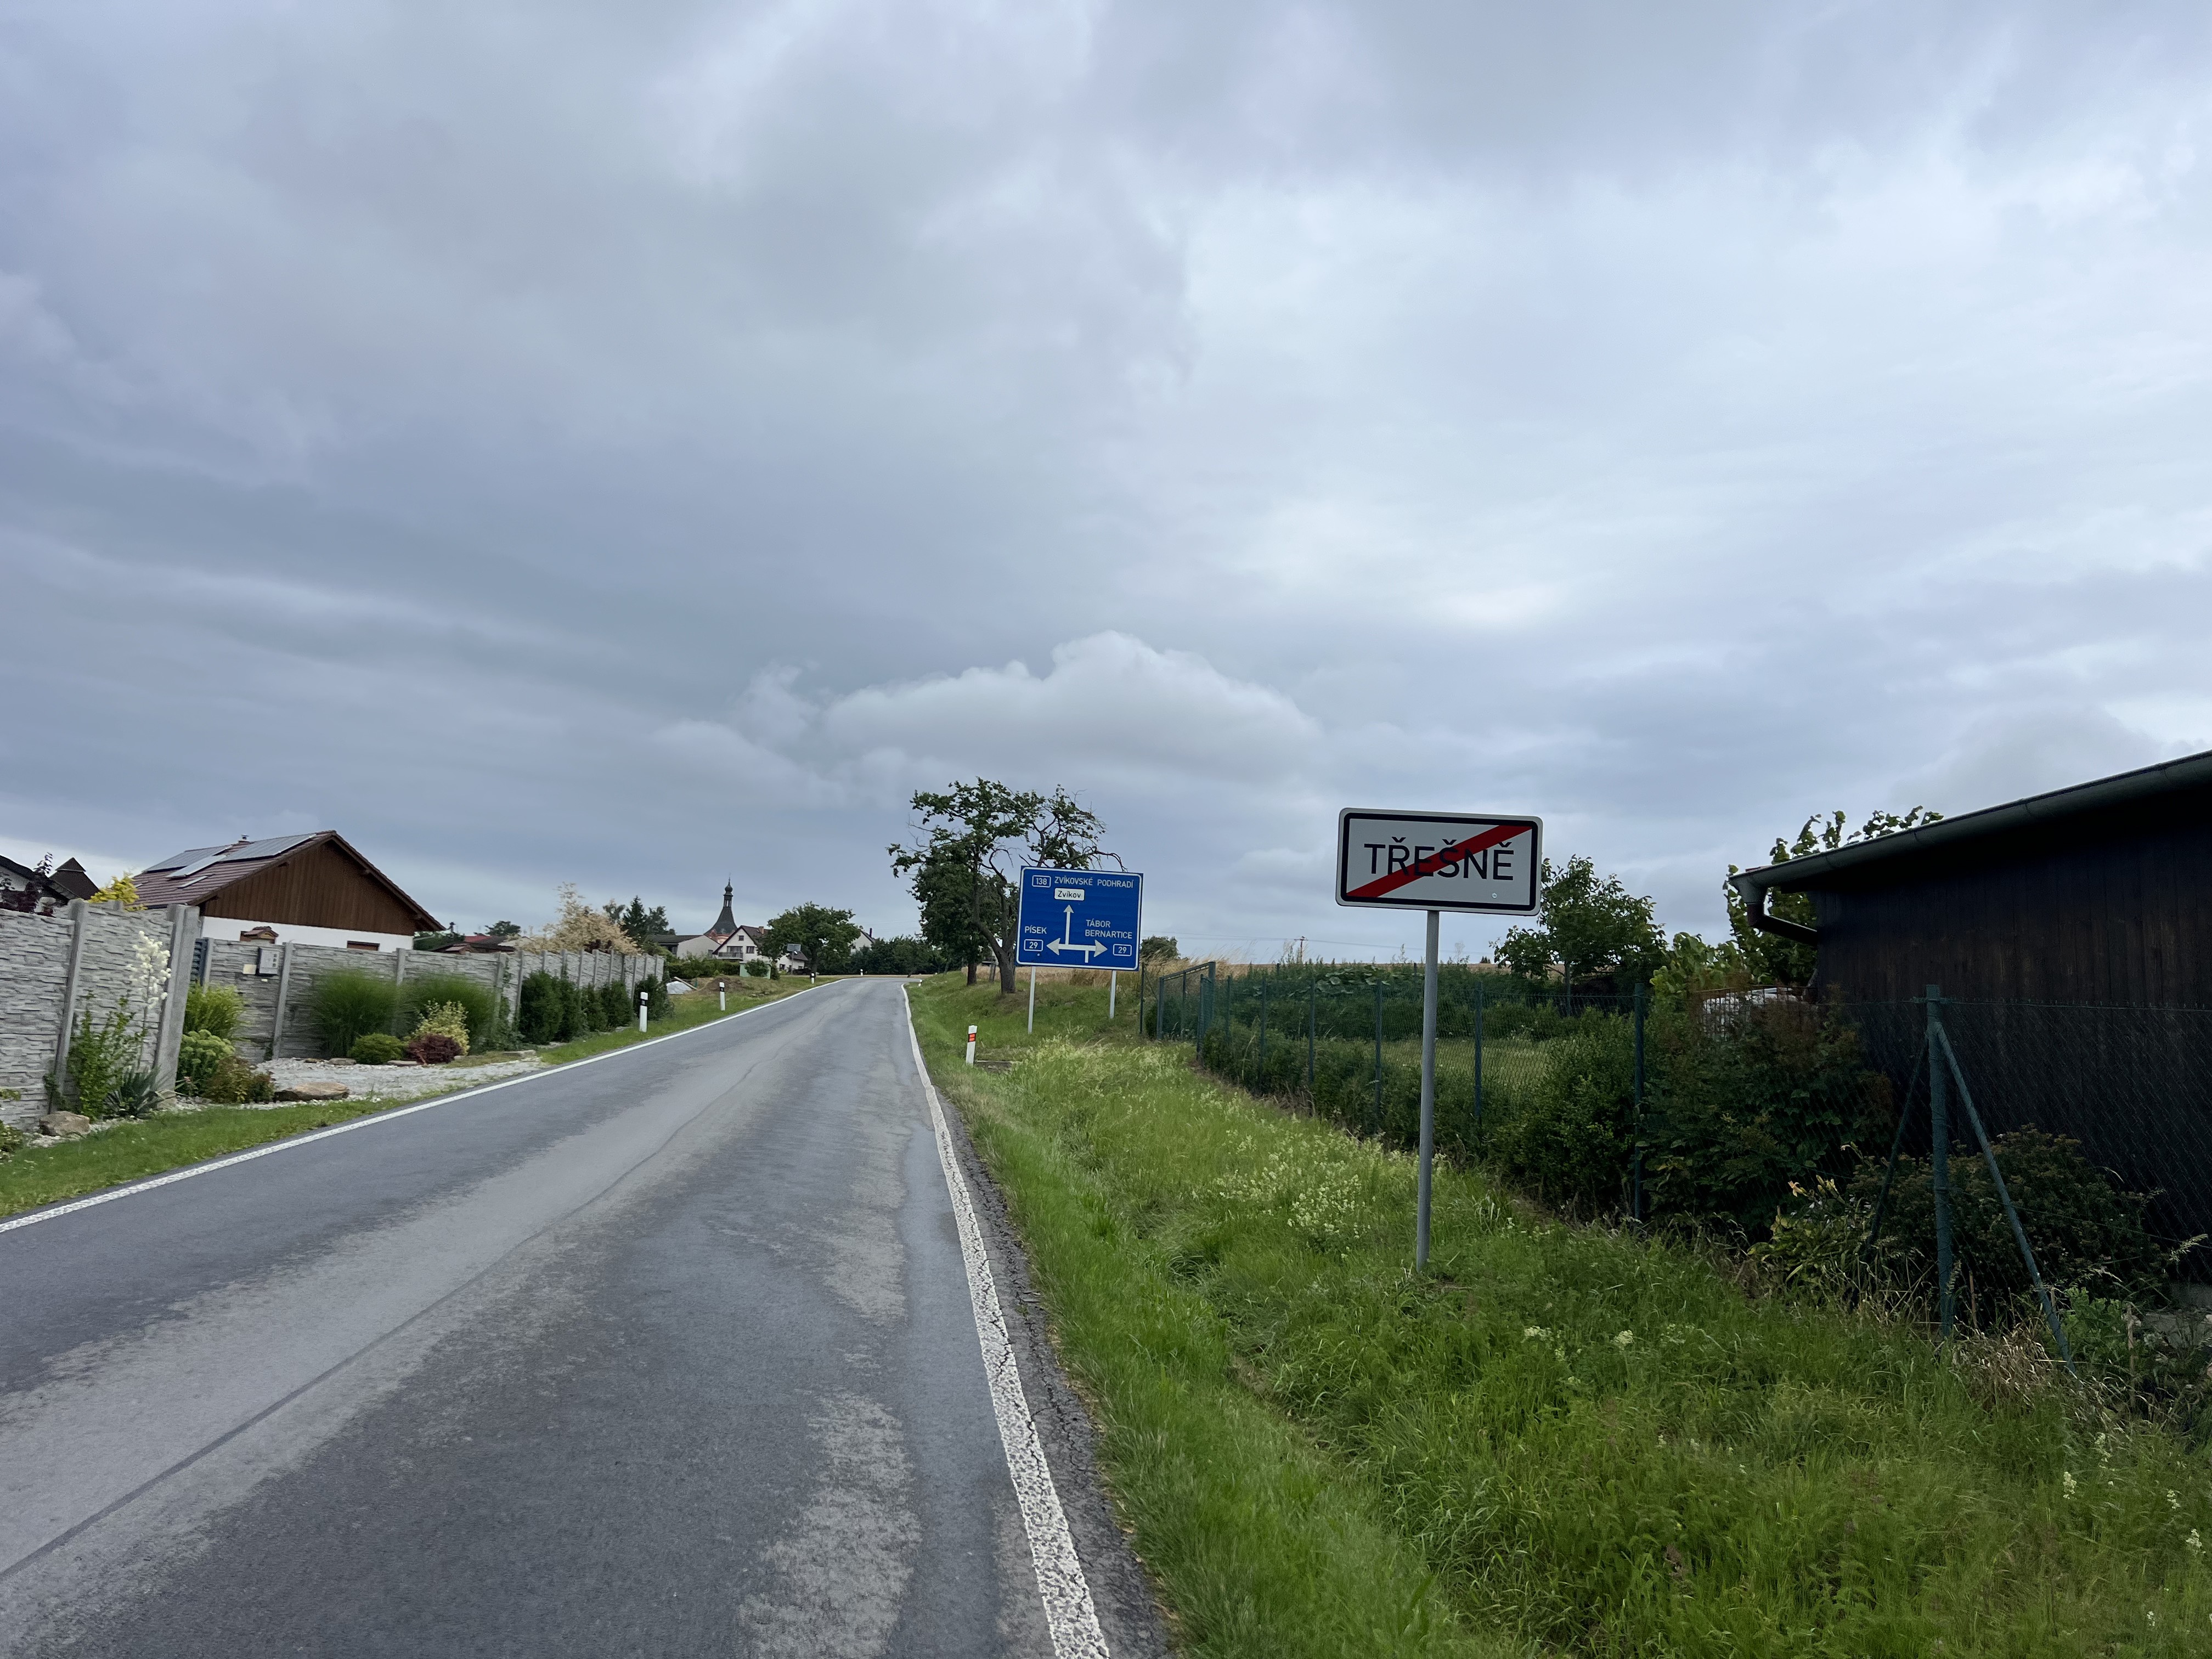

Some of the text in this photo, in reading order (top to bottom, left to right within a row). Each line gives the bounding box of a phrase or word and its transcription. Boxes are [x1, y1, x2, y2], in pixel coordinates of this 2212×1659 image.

[1364, 836, 1514, 881] TŘEŠNĚ
[1054, 875, 1134, 888] ZVÍKOVSKÉ PODHRADÍ
[1086, 918, 1111, 928] TÁBOR
[1024, 924, 1047, 934] PÍSEK
[1085, 929, 1132, 939] BERNARTICE
